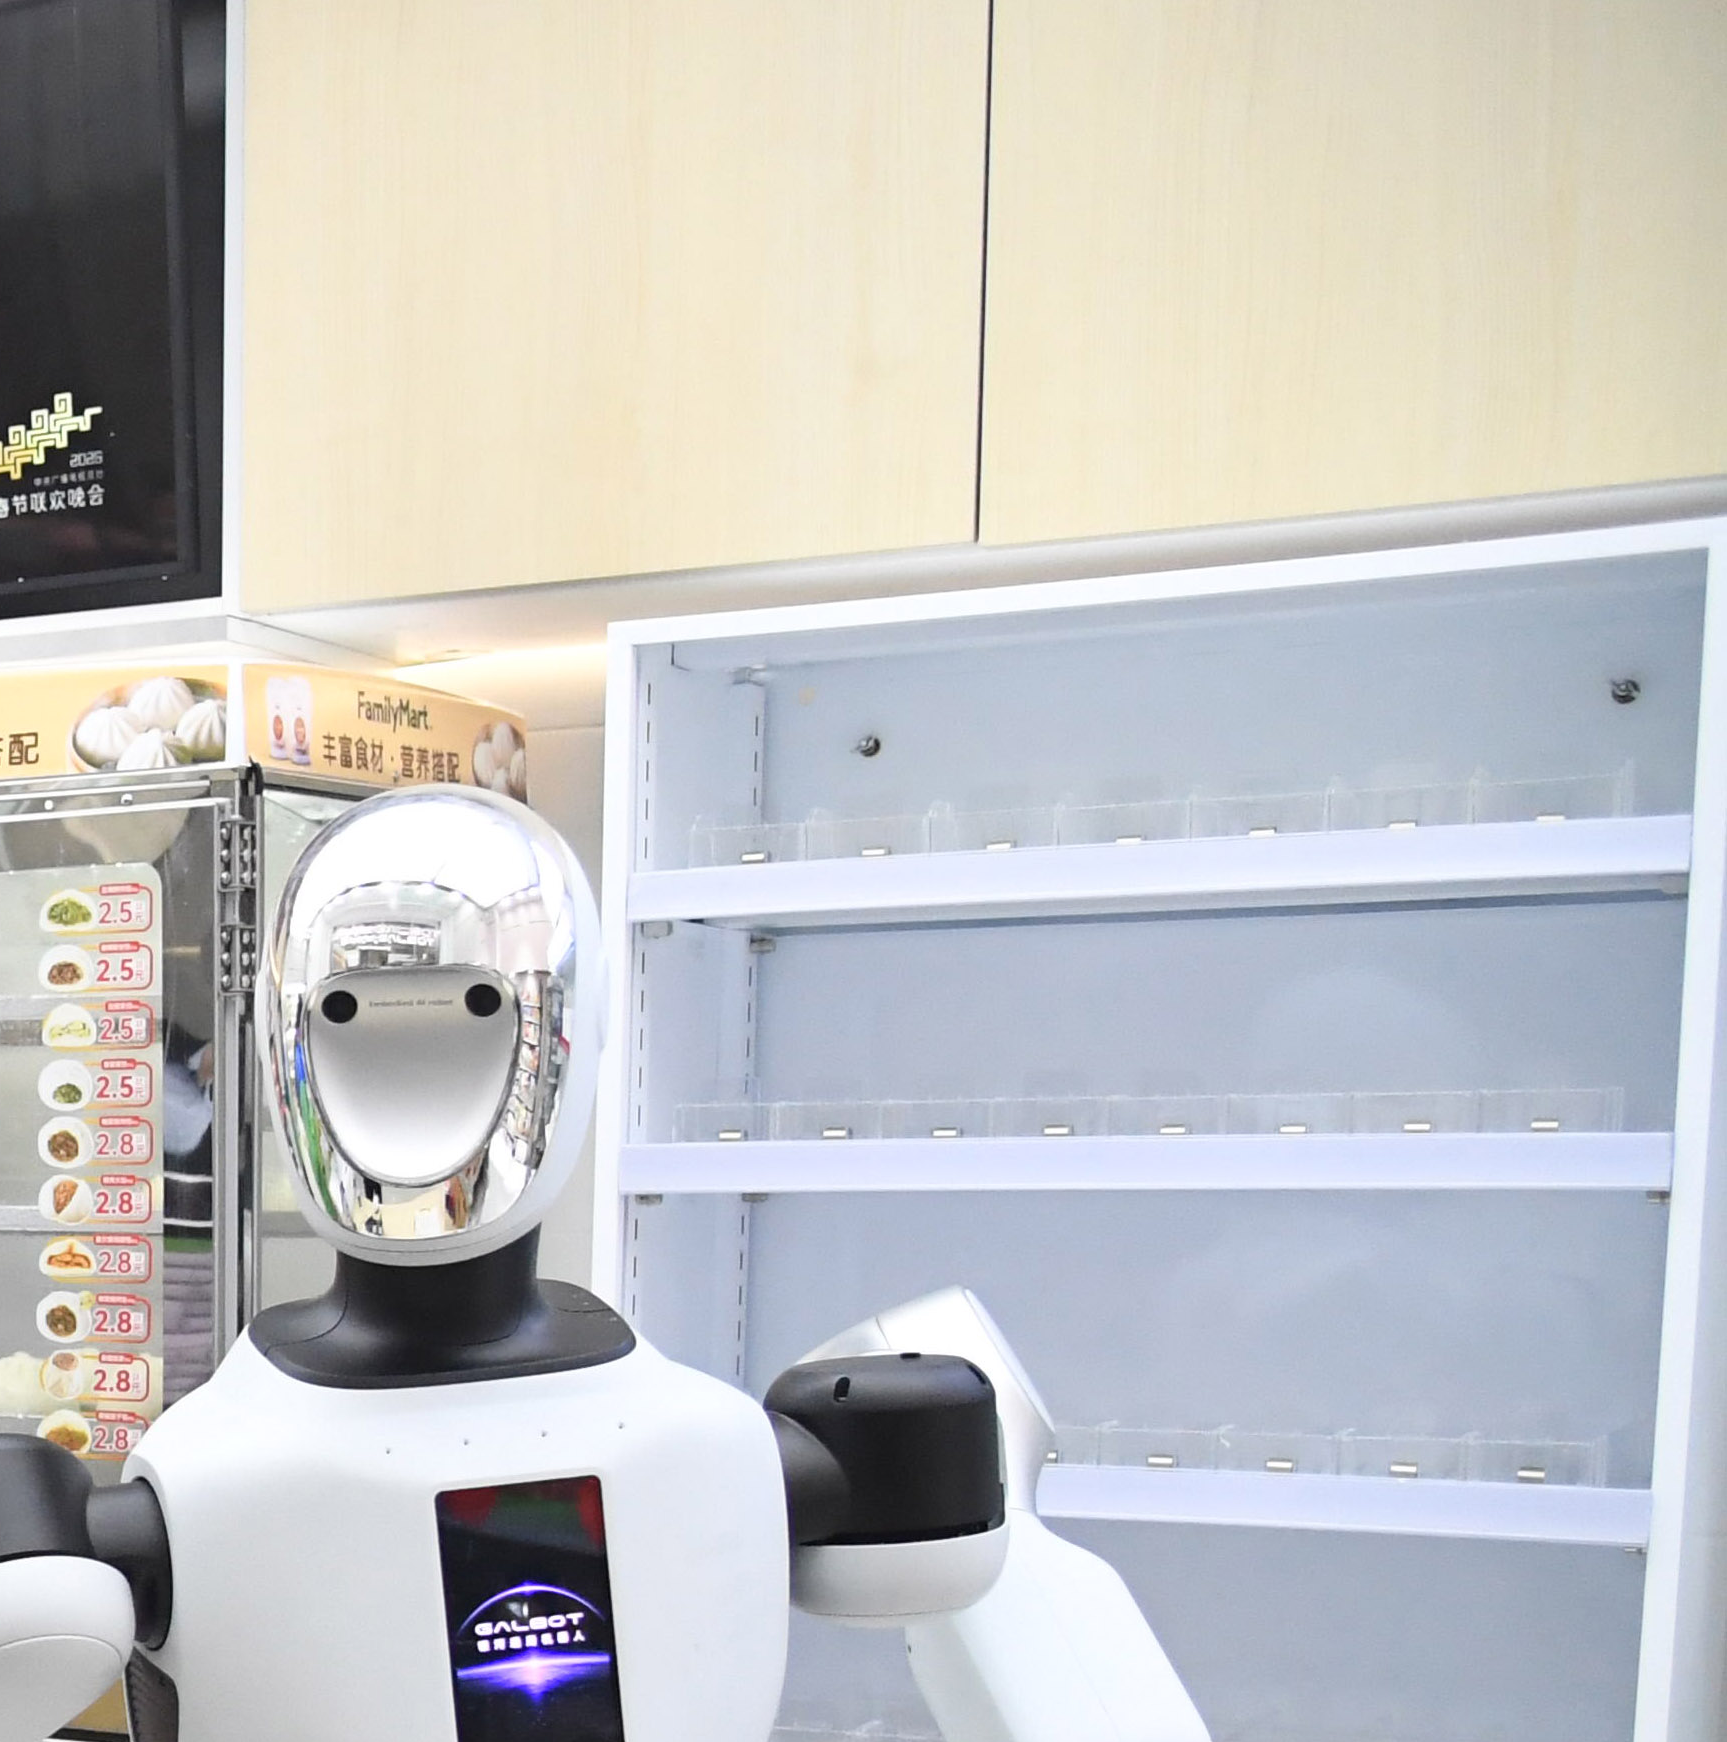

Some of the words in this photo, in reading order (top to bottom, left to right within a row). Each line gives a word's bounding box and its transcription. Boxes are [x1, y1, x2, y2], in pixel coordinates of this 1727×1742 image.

[357, 691, 429, 733] FamilyMart
[322, 732, 461, 783] 丰富食材·营养搭配
[99, 901, 132, 924] 2.5
[97, 958, 134, 983] 2.5
[100, 1018, 134, 1042] 2.5
[97, 1075, 134, 1099] 2.5
[97, 1132, 133, 1156] 2.8
[96, 1190, 133, 1215] 2.8
[99, 1250, 132, 1274] 2.8
[94, 1308, 132, 1333] 2.8
[93, 1368, 131, 1393] 2.8
[94, 1427, 128, 1450] 2.8
[474, 1612, 585, 1637] GALBOT
